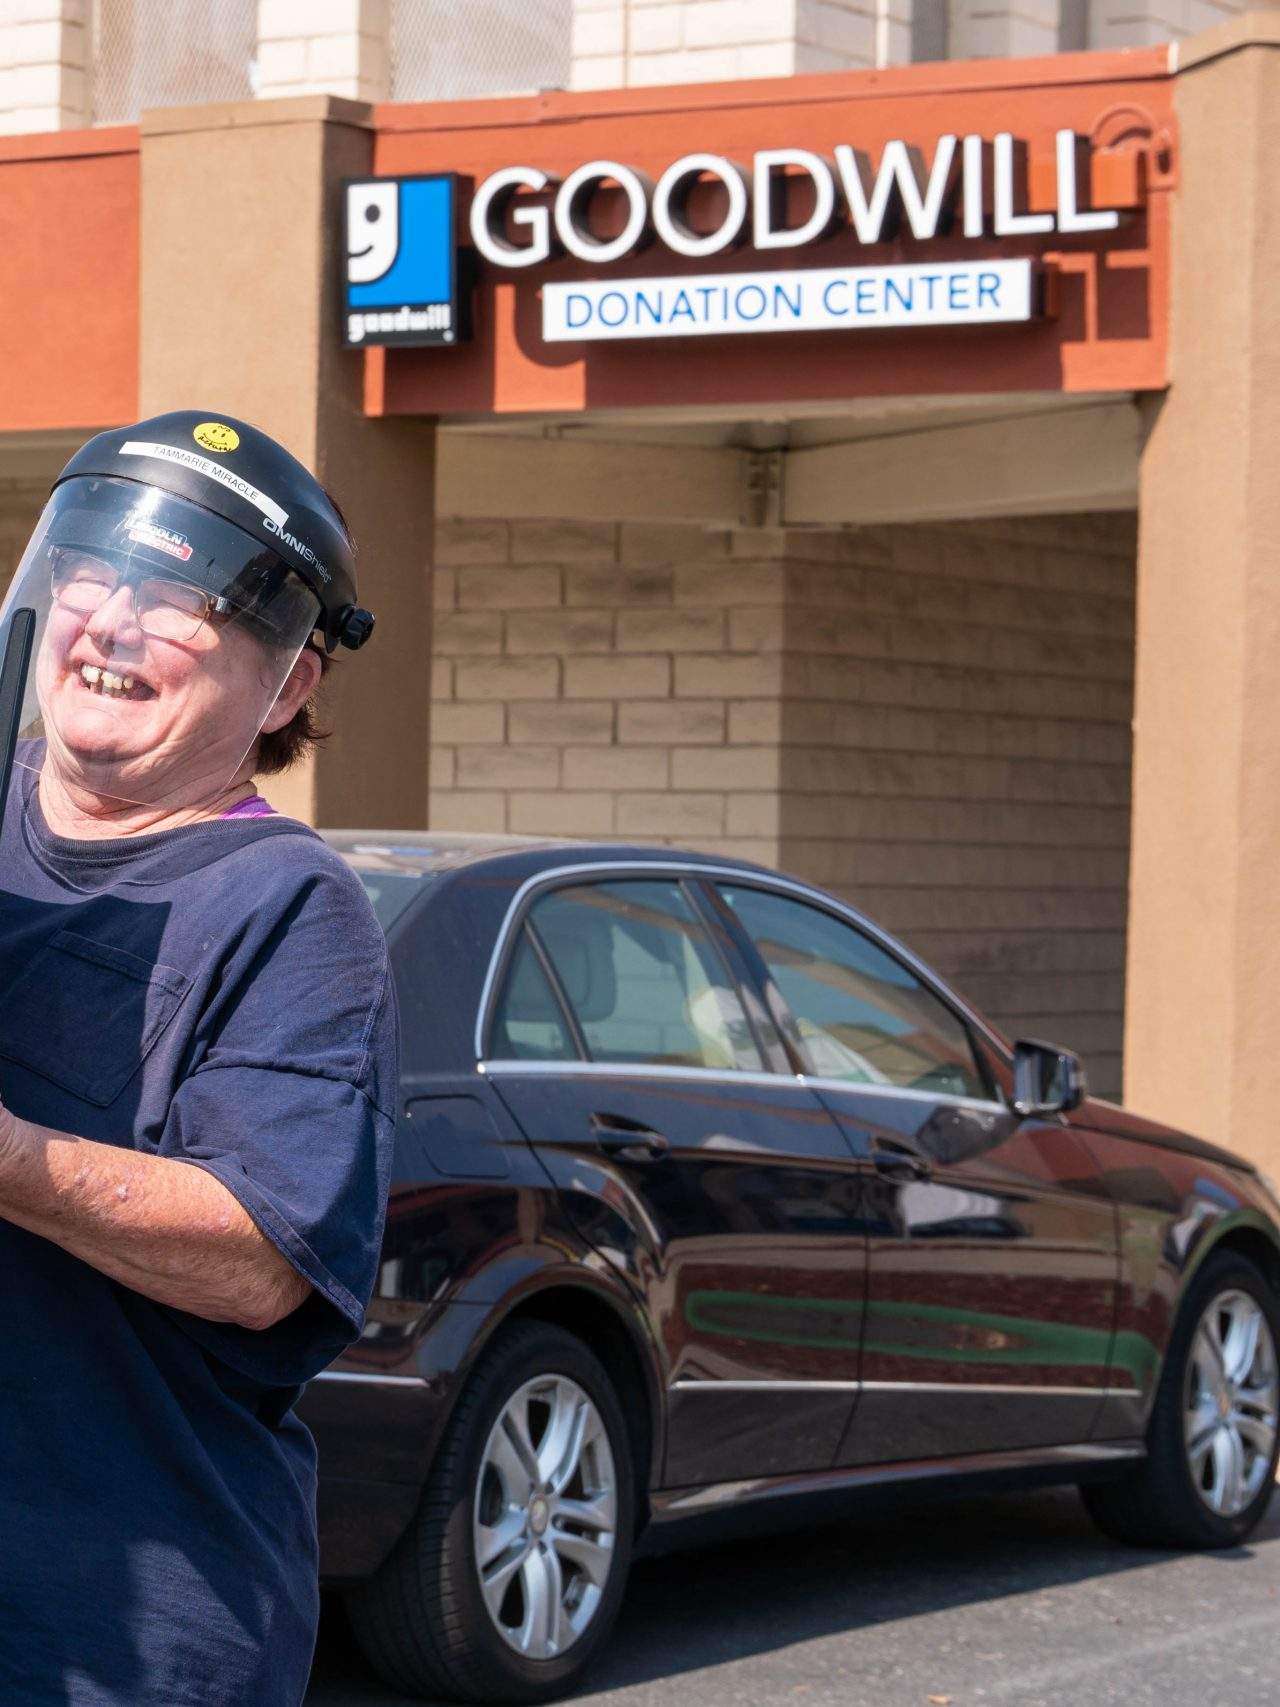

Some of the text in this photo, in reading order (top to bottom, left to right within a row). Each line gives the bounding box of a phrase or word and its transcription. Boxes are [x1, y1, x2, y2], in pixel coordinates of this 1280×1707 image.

[470, 128, 1119, 268] GOODWILL
[565, 274, 1001, 329] DONATION CENTER
[153, 446, 260, 501] TAMMARIE MIRACLE
